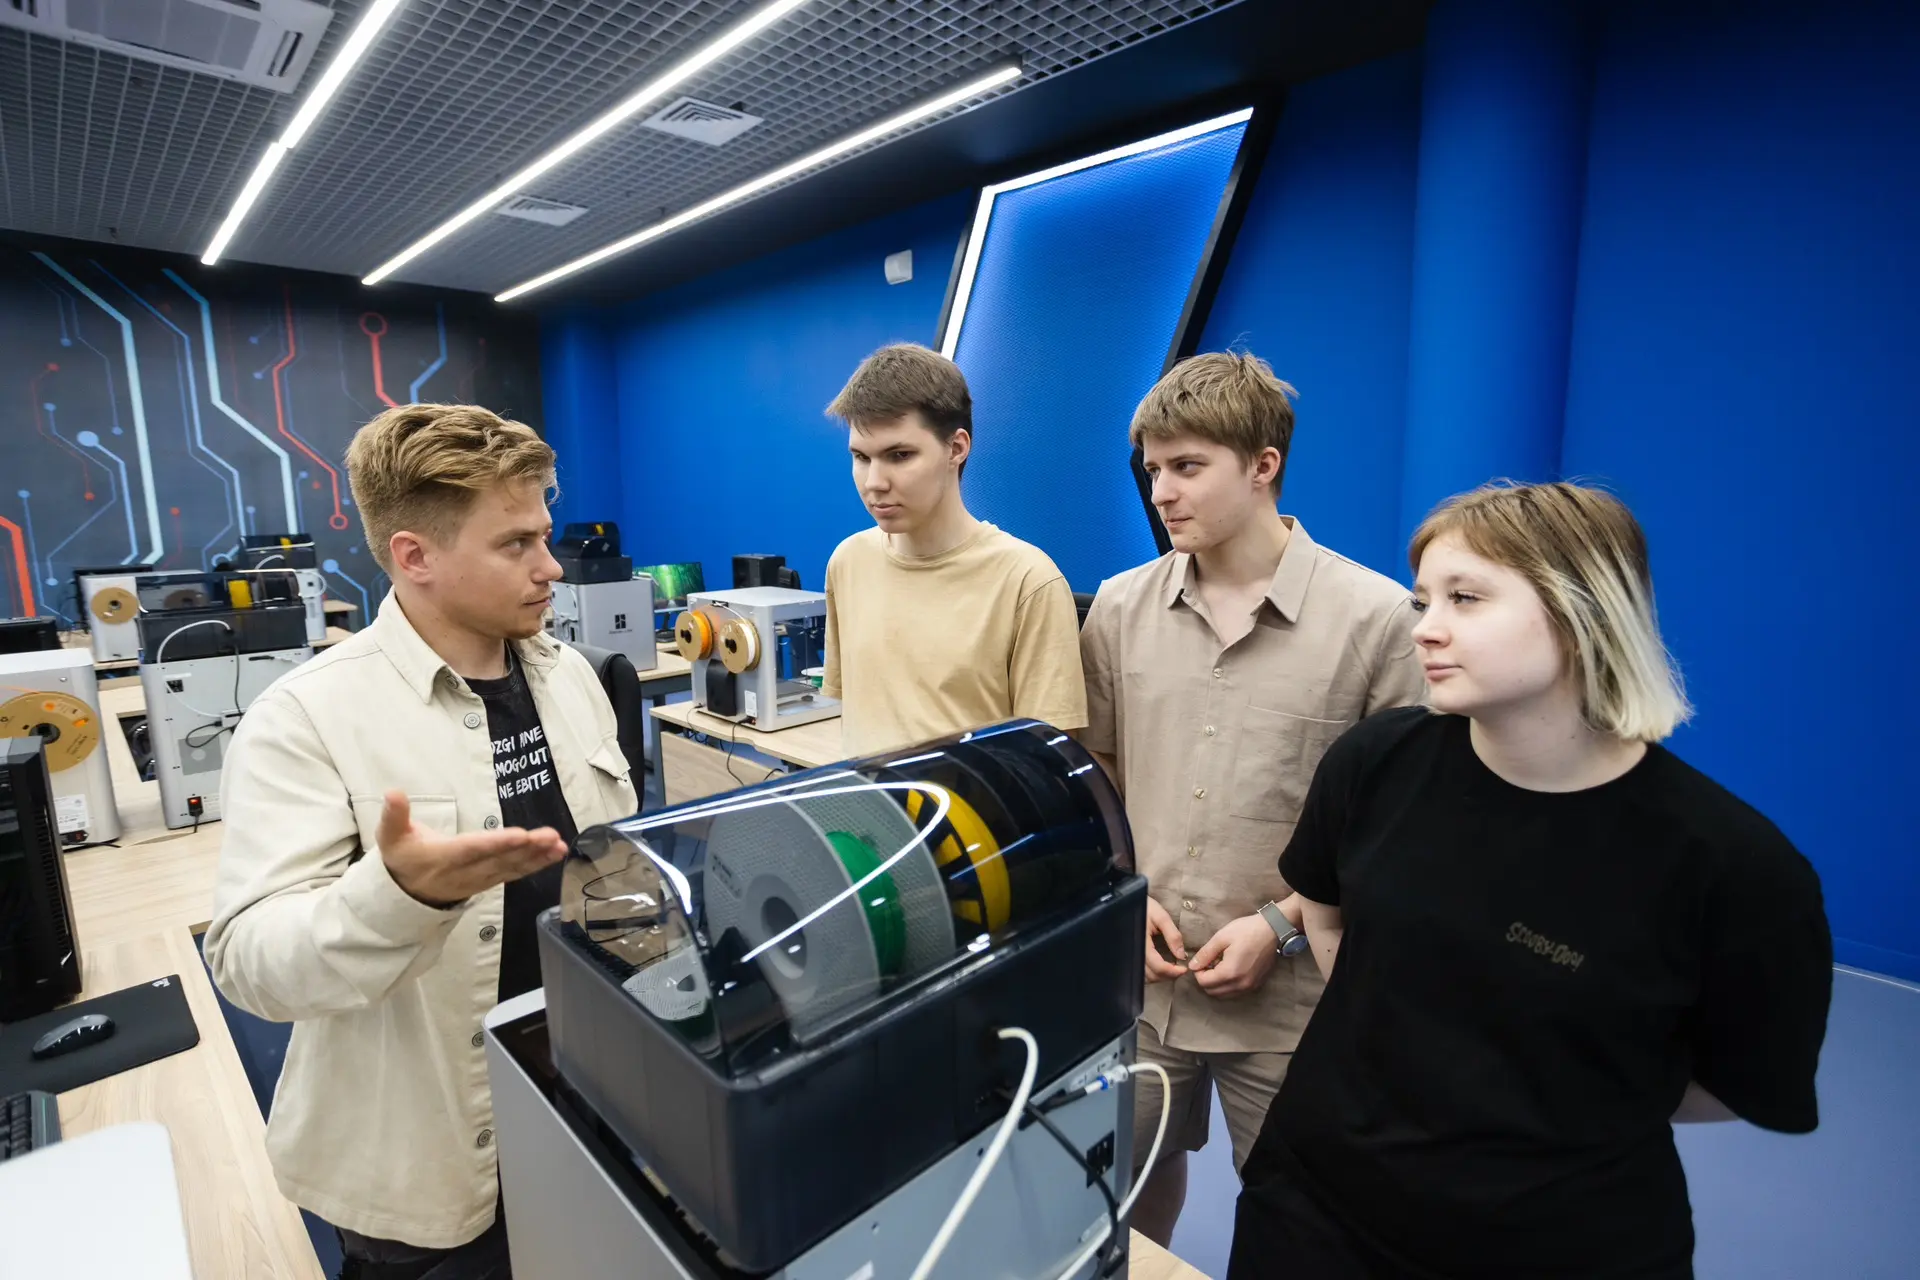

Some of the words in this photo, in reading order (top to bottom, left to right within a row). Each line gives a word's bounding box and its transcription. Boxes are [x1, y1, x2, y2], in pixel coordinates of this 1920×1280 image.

[494, 755, 528, 779] MOGO
[498, 782, 515, 799] NE
[516, 769, 551, 795] EBITE
